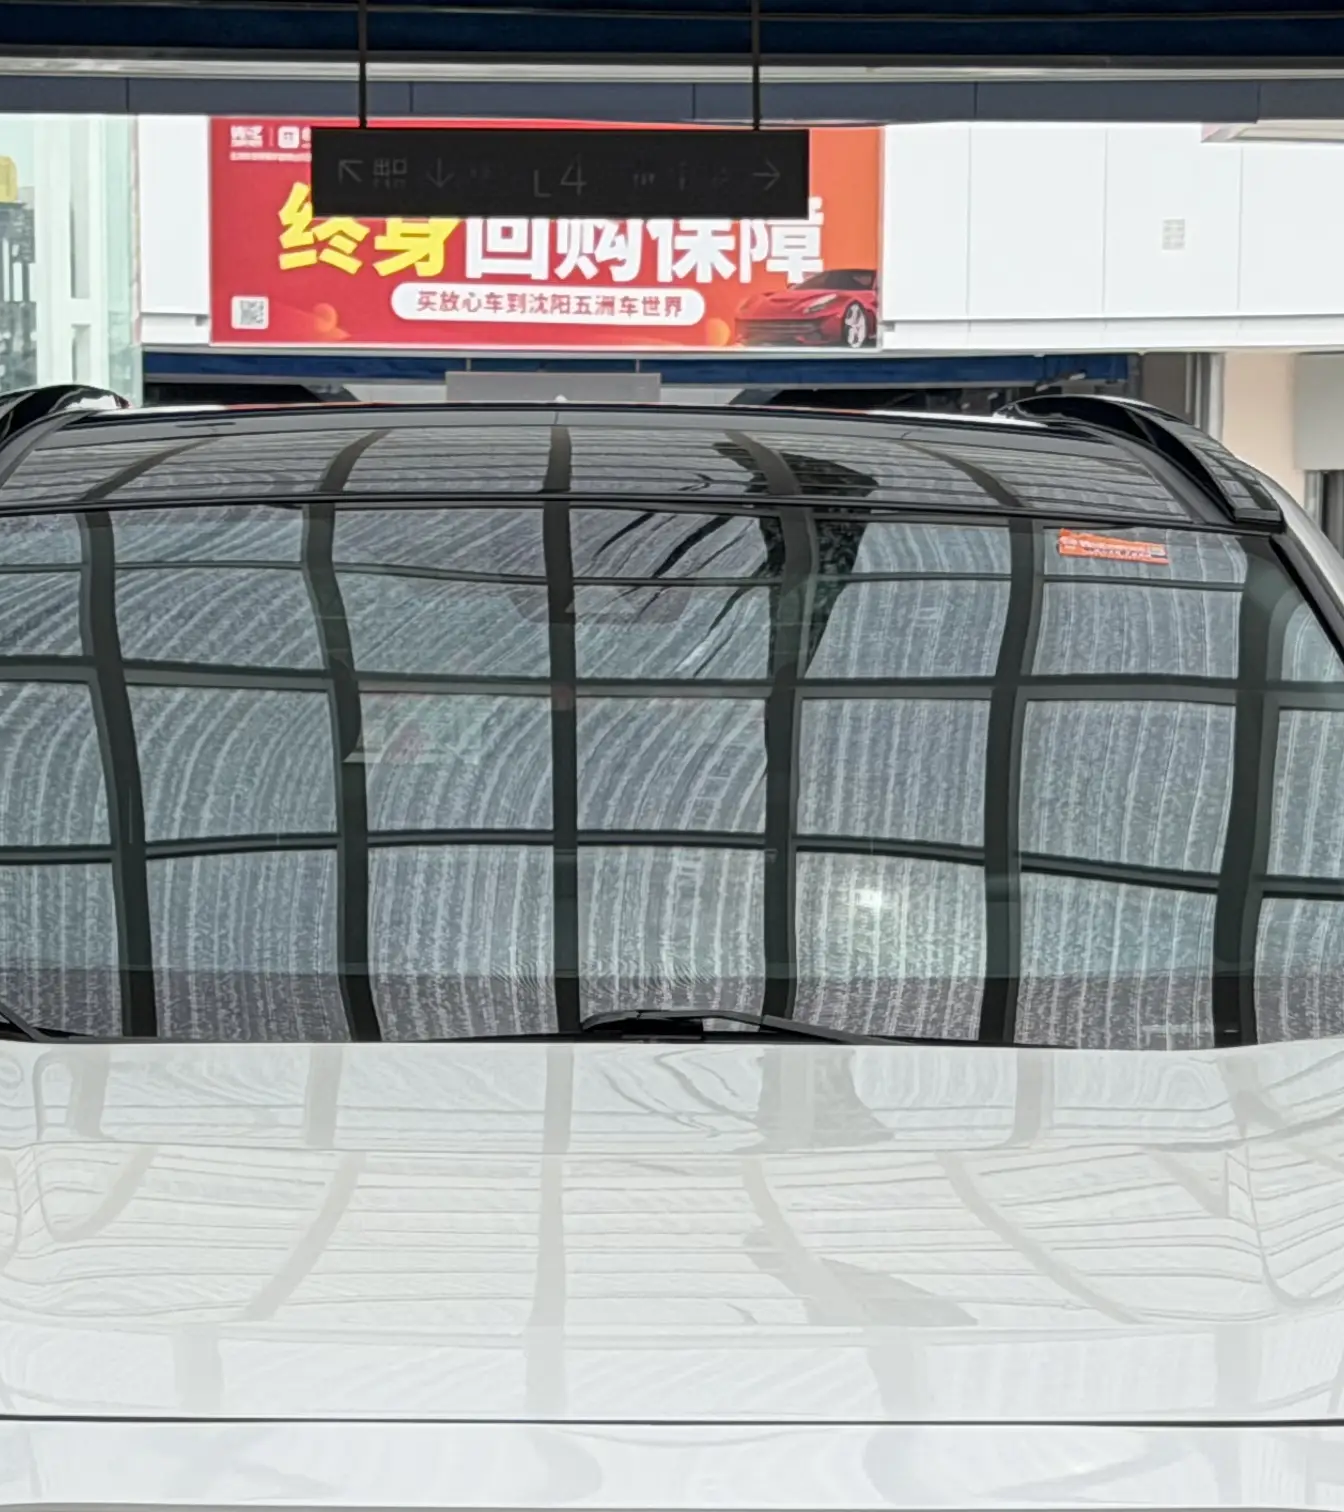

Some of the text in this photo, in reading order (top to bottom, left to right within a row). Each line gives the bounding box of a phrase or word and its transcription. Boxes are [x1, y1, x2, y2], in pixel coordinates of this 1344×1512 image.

[278, 182, 824, 284] 终身回购保障
[416, 290, 683, 318] 买放心车到沈阳五洲车世界
